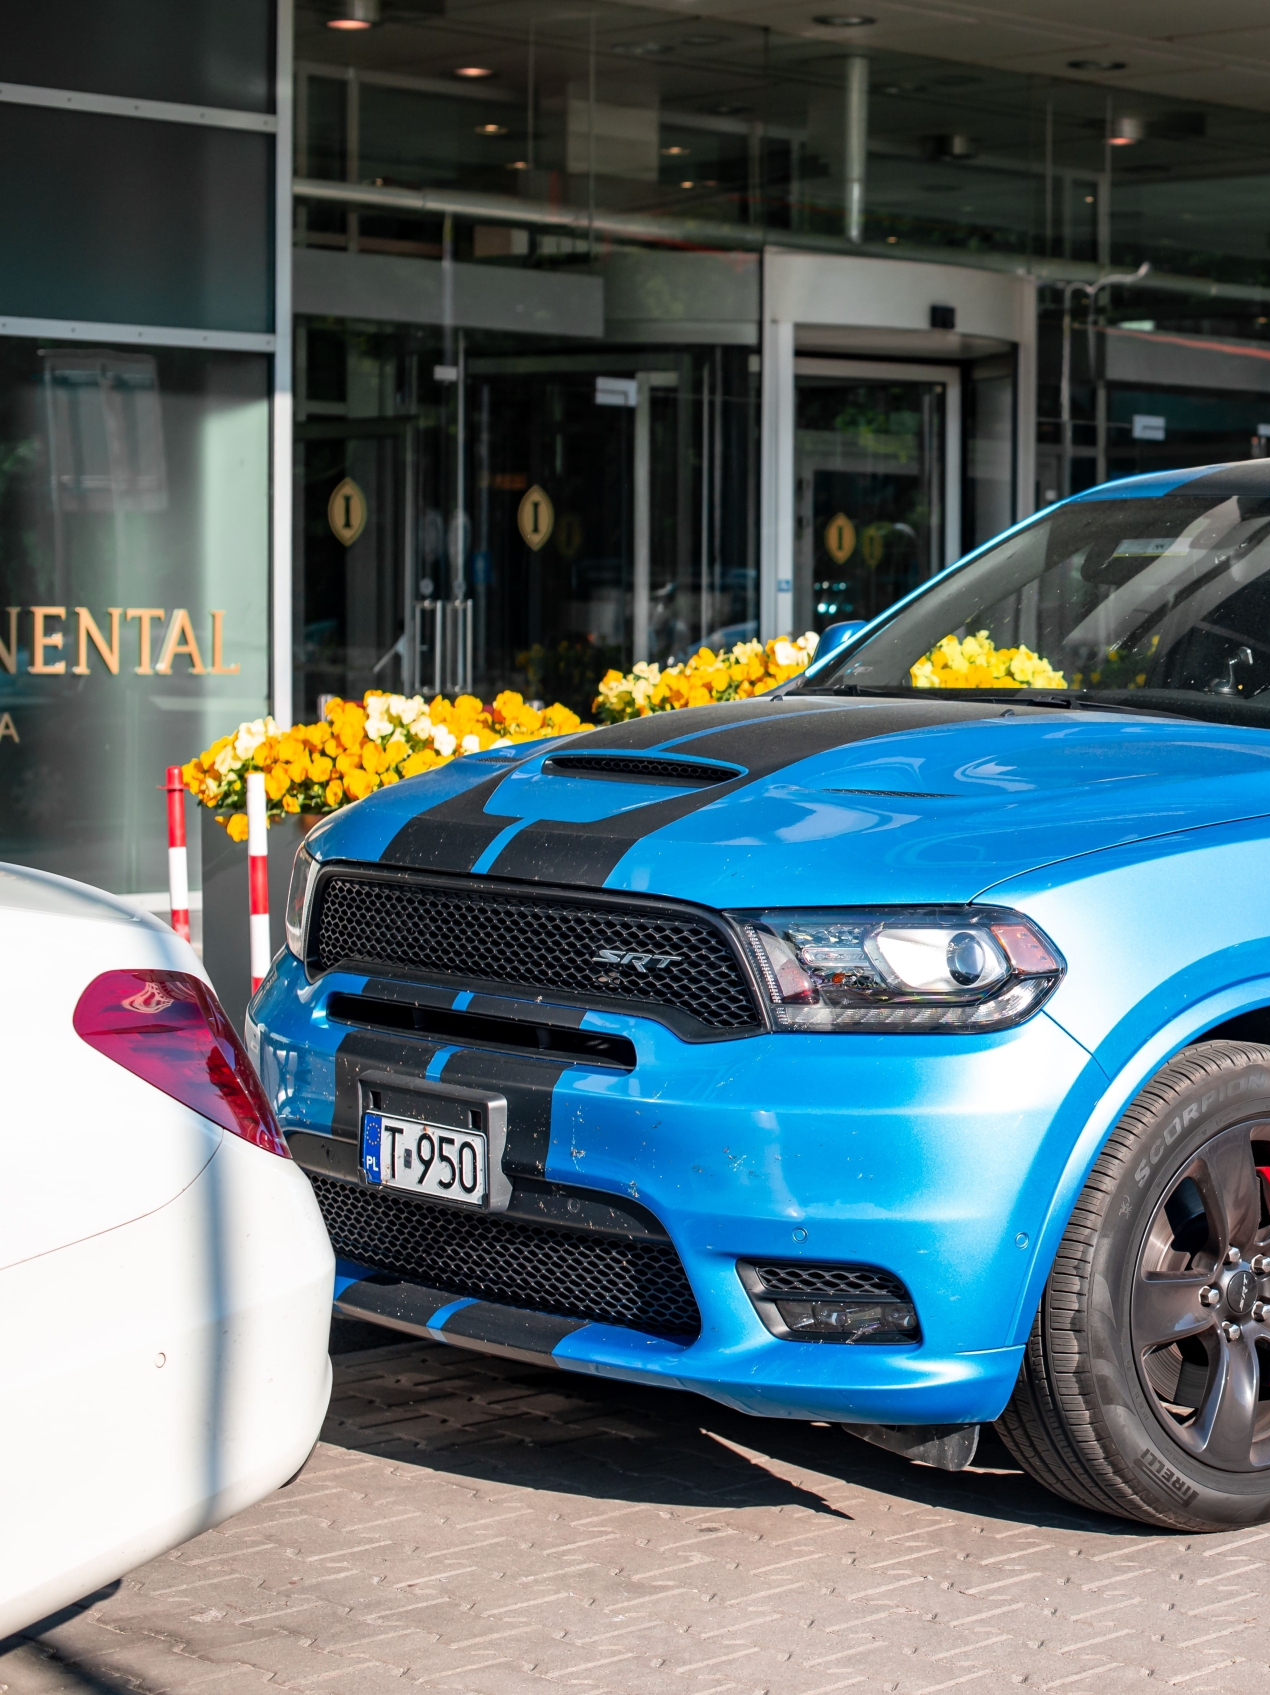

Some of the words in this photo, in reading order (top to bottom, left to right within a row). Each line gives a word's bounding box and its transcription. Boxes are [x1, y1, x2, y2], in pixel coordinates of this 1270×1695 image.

[592, 949, 683, 972] SRT
[1134, 1071, 1267, 1188] SCORPION
[366, 1155, 379, 1171] PL
[1133, 1447, 1200, 1508] PIRELLI
